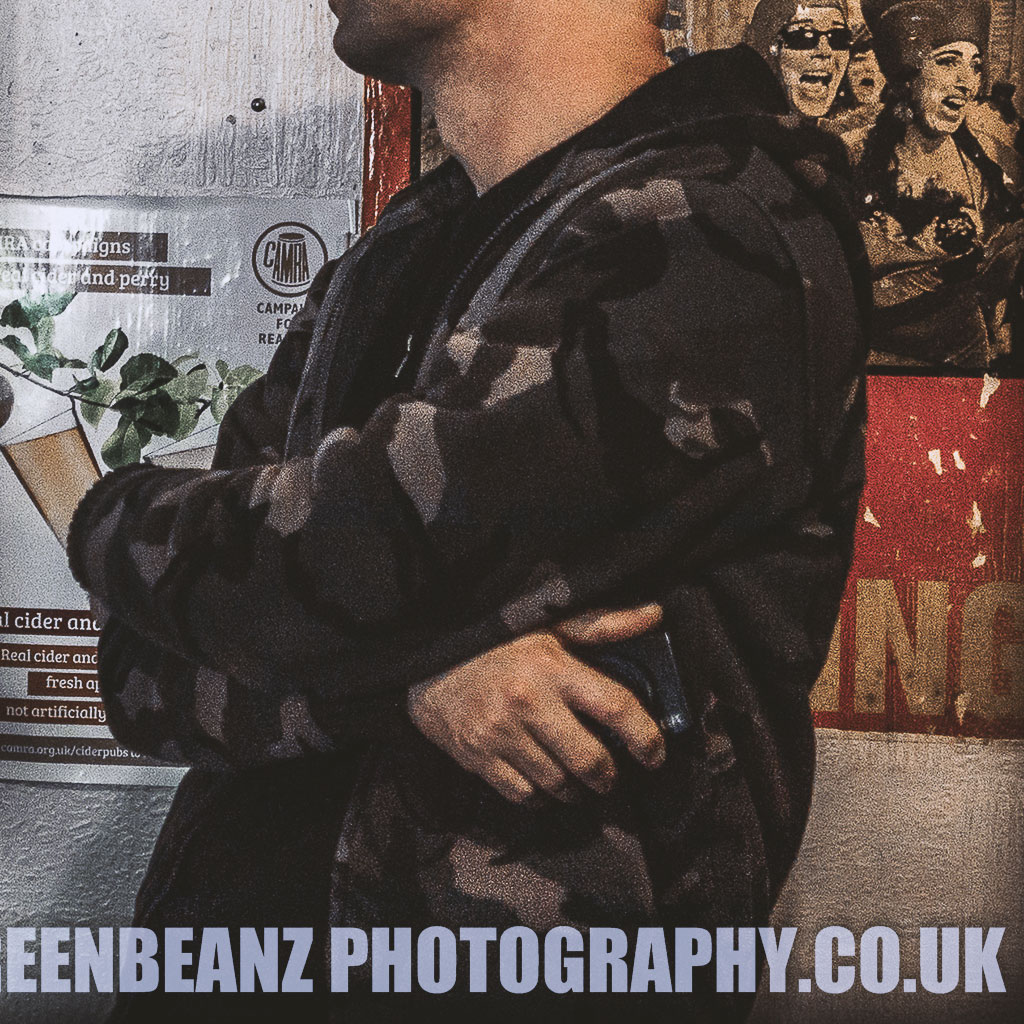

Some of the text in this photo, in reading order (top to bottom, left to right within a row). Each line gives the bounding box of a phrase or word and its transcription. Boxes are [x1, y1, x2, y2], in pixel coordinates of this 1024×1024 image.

[262, 241, 310, 284] CAMRA
[80, 269, 116, 286] and
[118, 273, 170, 291] perry
[276, 319, 291, 330] FO
[259, 333, 284, 345] REA
[14, 612, 63, 630] cider
[1, 648, 31, 662] Real
[34, 650, 72, 664] cider
[46, 676, 83, 690] fresh
[6, 705, 106, 722] not artificially
[1, 744, 129, 759] camra.org.uk/ciderpubs
